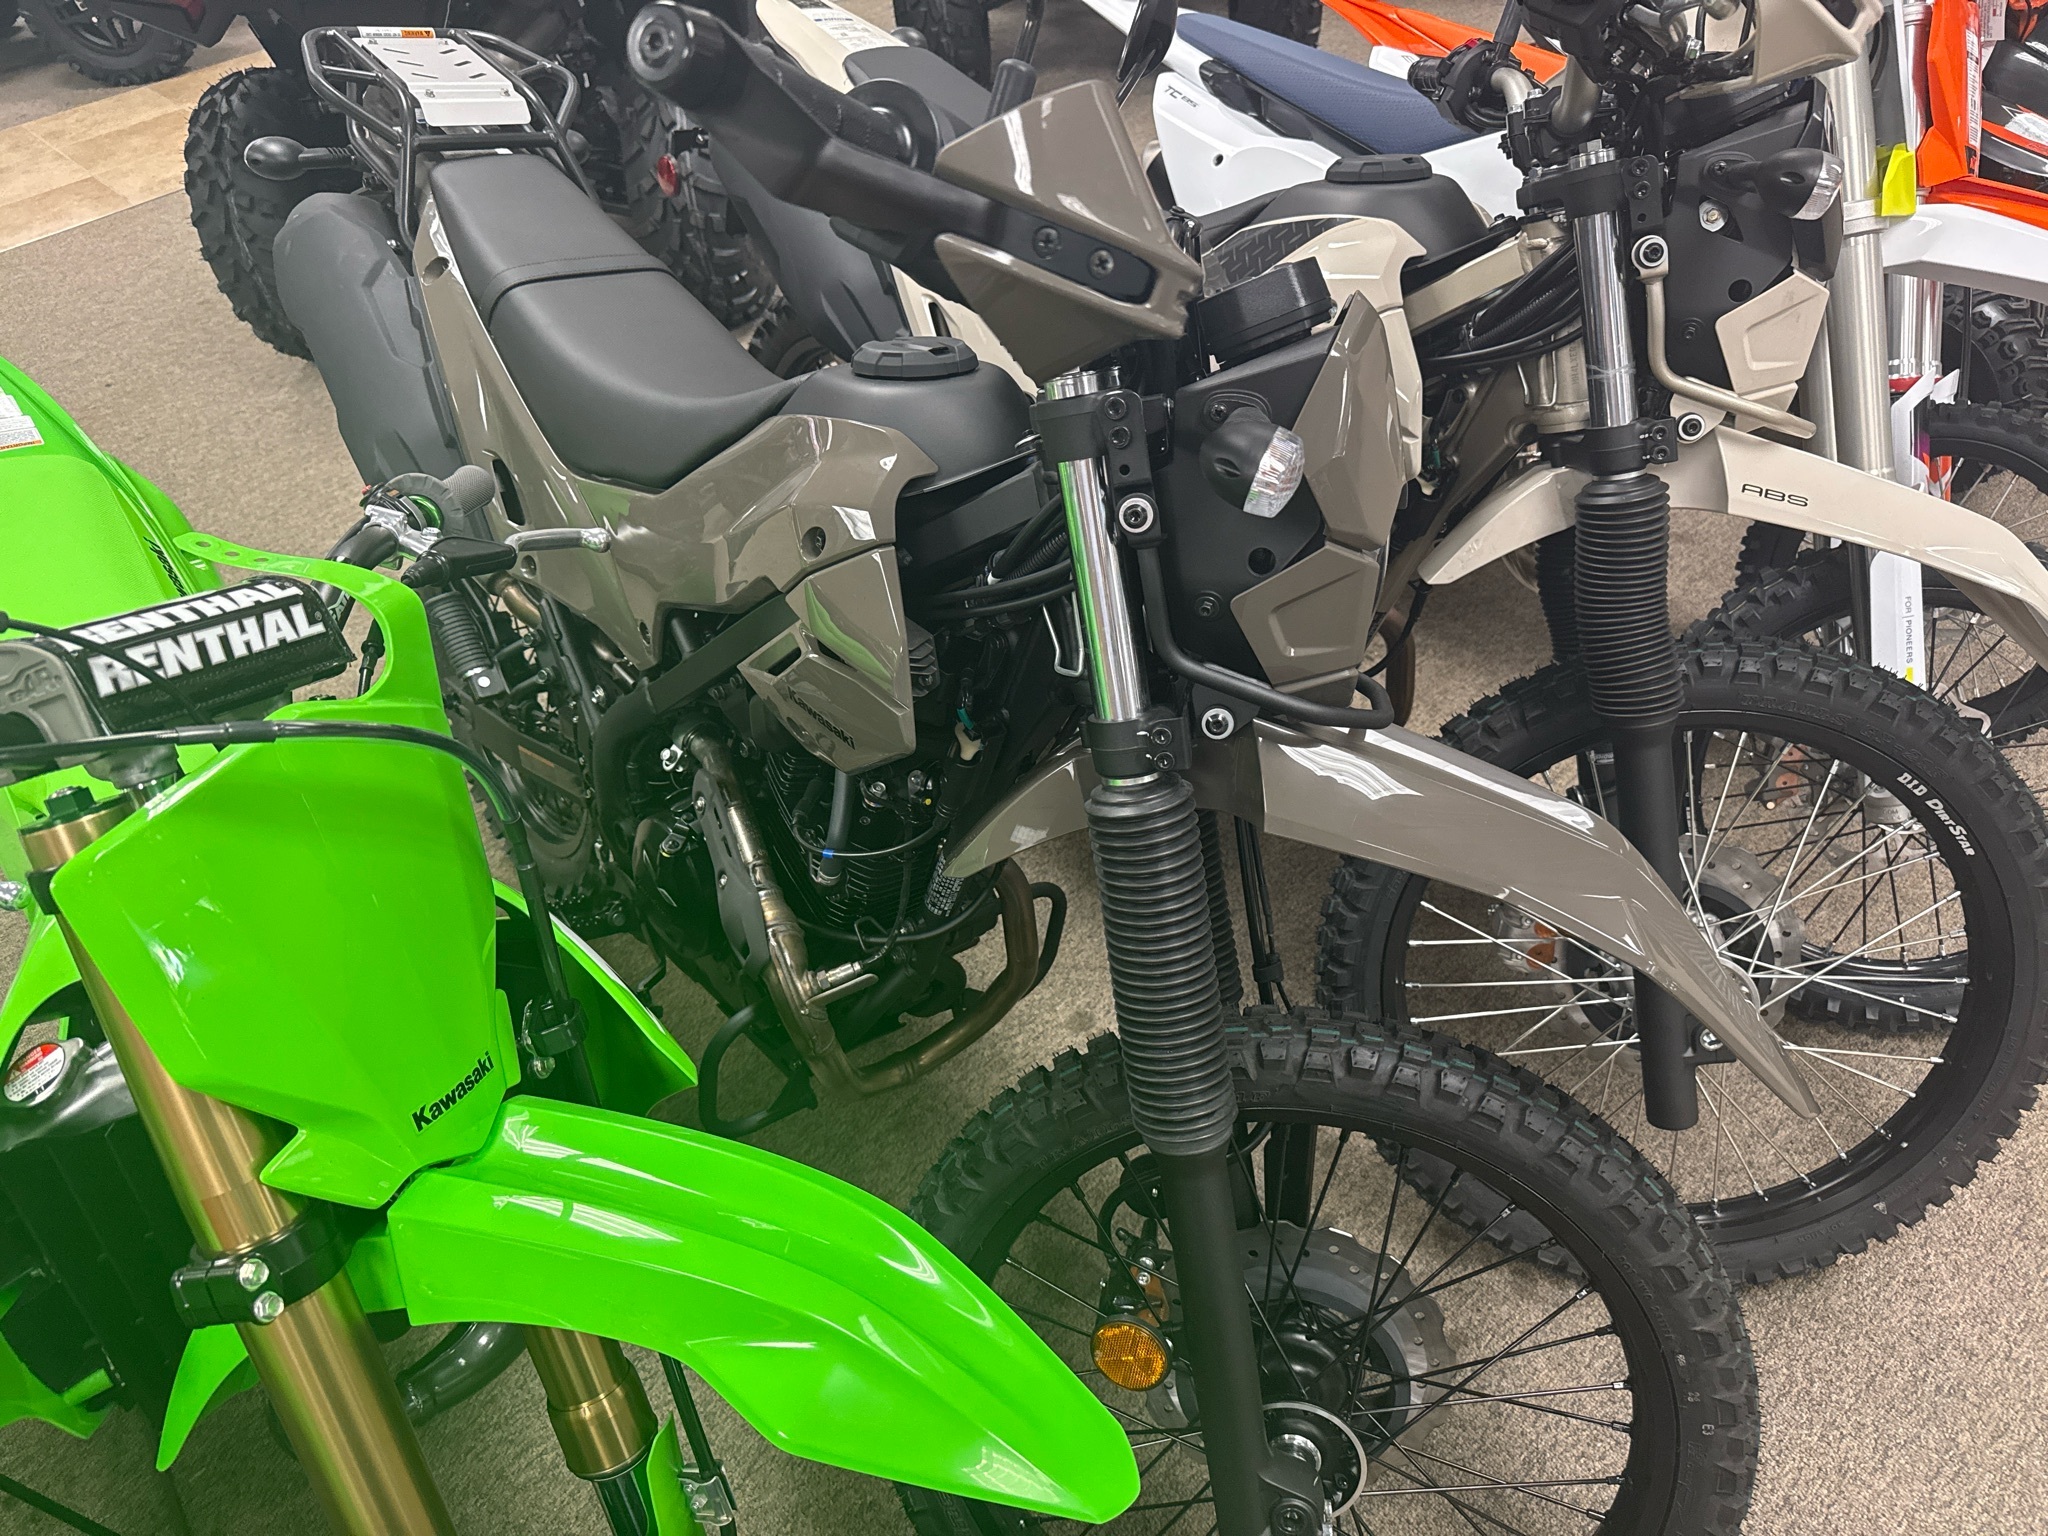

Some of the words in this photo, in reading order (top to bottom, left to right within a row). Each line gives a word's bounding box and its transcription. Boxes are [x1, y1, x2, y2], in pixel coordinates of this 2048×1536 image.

[1164, 85, 1183, 99] TC
[1741, 483, 1809, 507] ABS
[1904, 595, 1913, 614] FOR
[1904, 619, 1914, 664] PIONEERS
[787, 685, 856, 750] Kawasaki
[411, 1050, 495, 1133] Kawasaki
